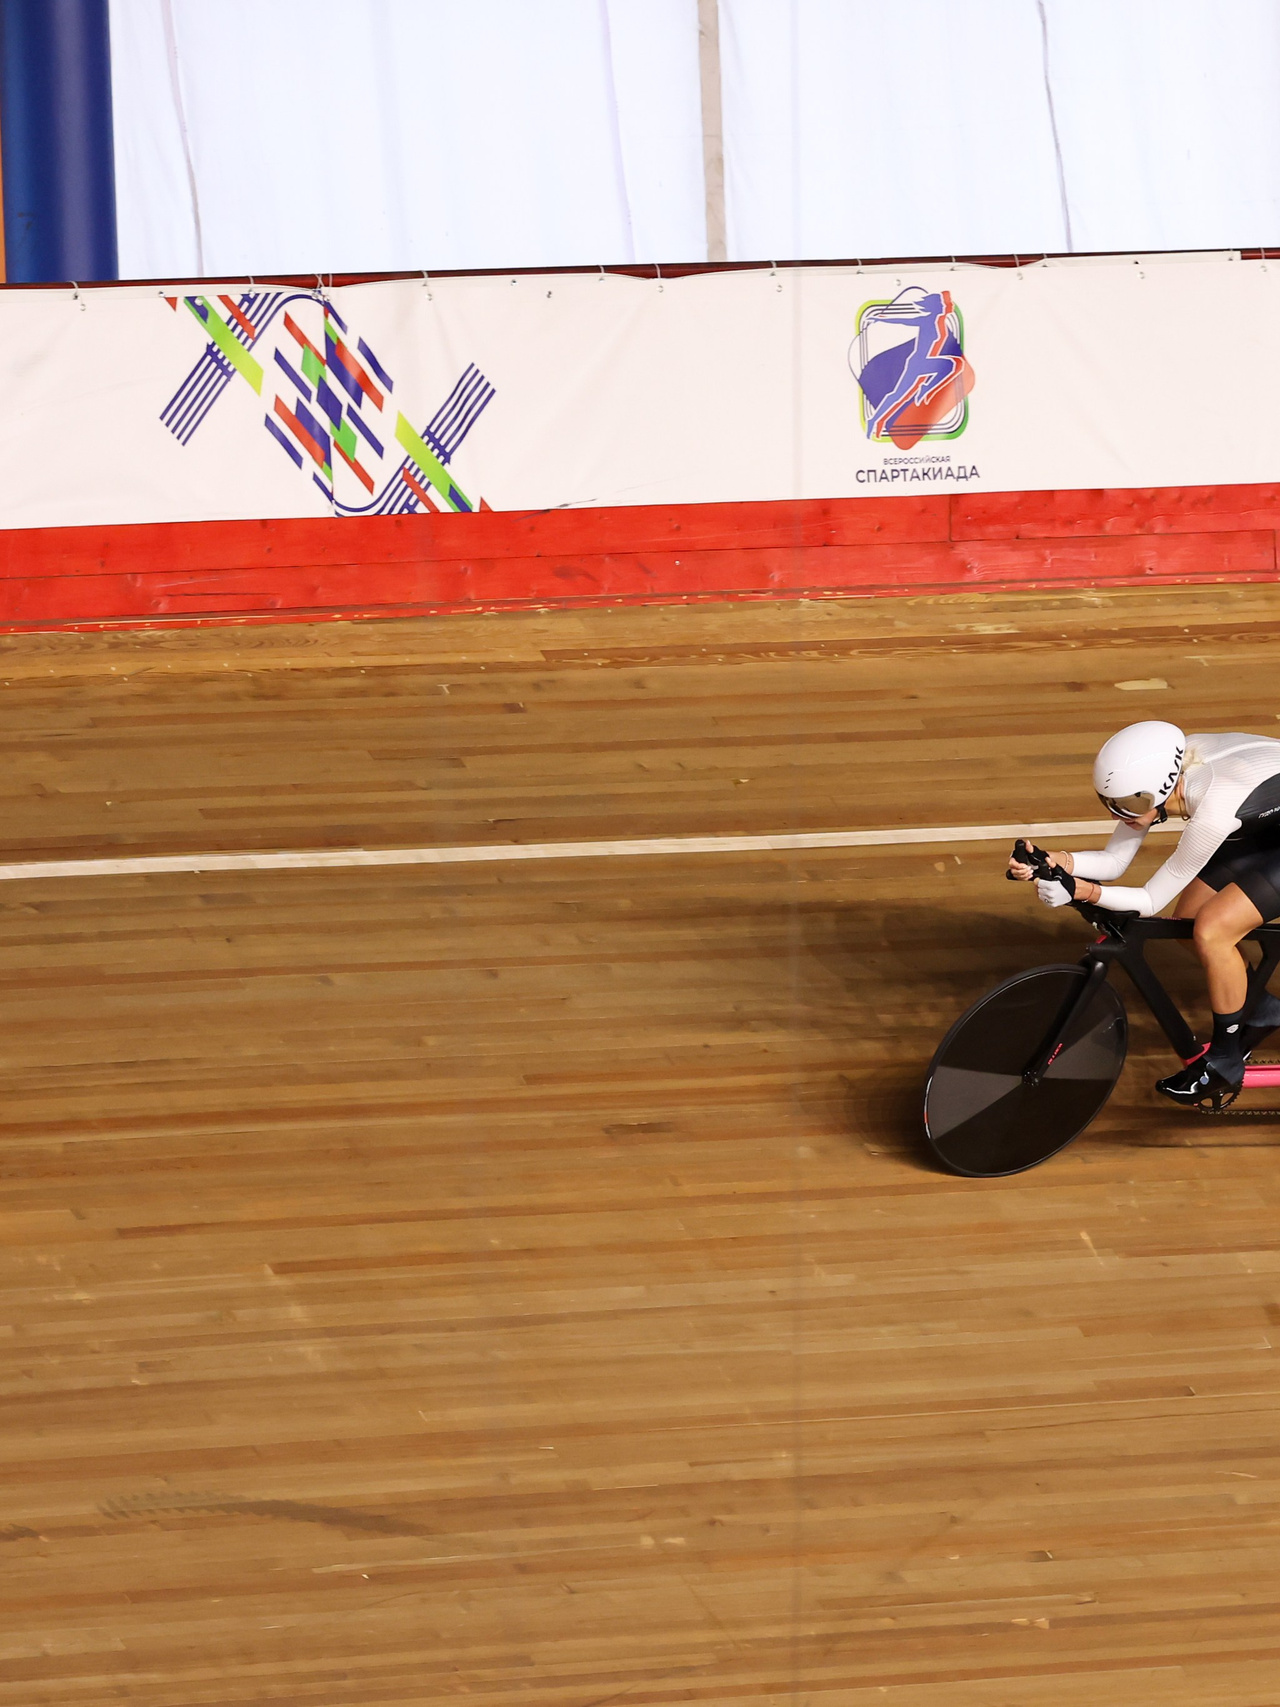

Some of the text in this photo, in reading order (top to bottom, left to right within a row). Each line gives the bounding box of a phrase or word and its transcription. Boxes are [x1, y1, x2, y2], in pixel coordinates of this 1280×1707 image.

[883, 455, 951, 466] ВСЕРОССИЙСКАЯ
[855, 465, 981, 484] СПАРТАКИАДА
[1158, 746, 1184, 796] KASK
